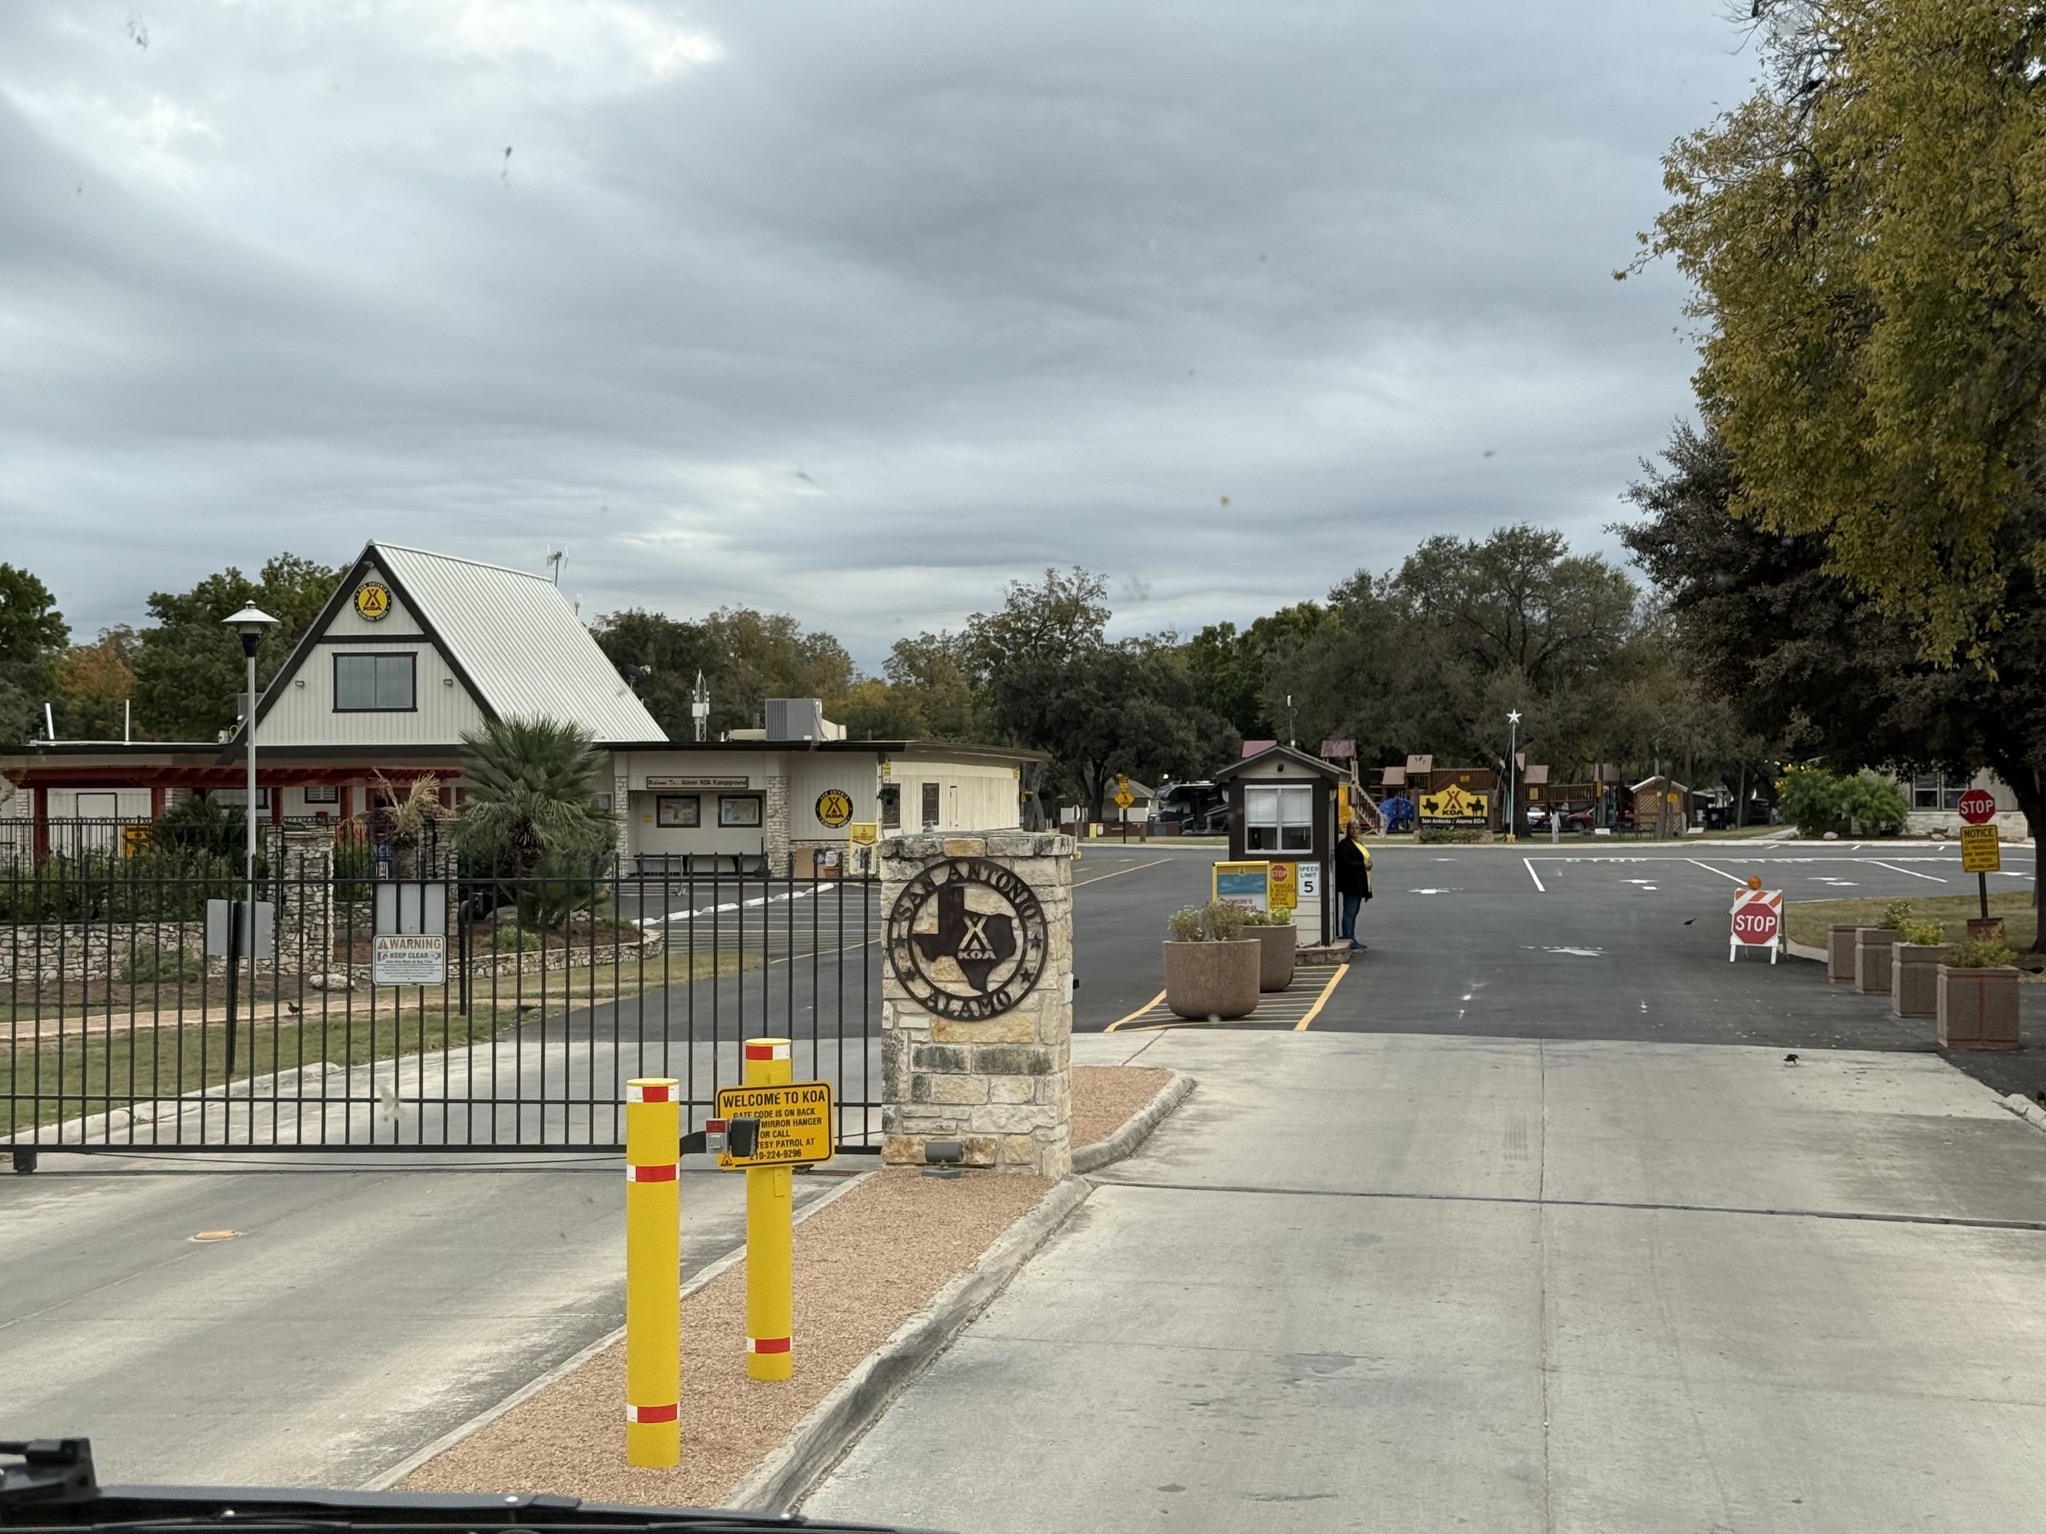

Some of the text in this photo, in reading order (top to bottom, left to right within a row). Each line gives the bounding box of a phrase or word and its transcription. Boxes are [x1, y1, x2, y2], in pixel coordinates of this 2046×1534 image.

[1960, 799, 1994, 815] STOP
[1964, 828, 1994, 838] NOTICE
[1271, 870, 1287, 878] STOP
[895, 862, 1039, 921] SAN ANTONIO
[1304, 881, 1314, 893] 5
[1735, 914, 1776, 933] STOP
[390, 938, 441, 950] WARNING
[957, 950, 997, 960] KOA
[926, 990, 1011, 1018] ALAMO
[723, 1090, 826, 1108] WELCOME TO KOA
[754, 1110, 773, 1118] CODE
[775, 1109, 782, 1117] IS
[784, 1109, 794, 1117] ON
[797, 1107, 816, 1116] BACK
[761, 1117, 822, 1128] MIRROR HANGER
[760, 1130, 790, 1139] OR CALL
[775, 1139, 803, 1148] PATROL
[806, 1138, 815, 1146] AT
